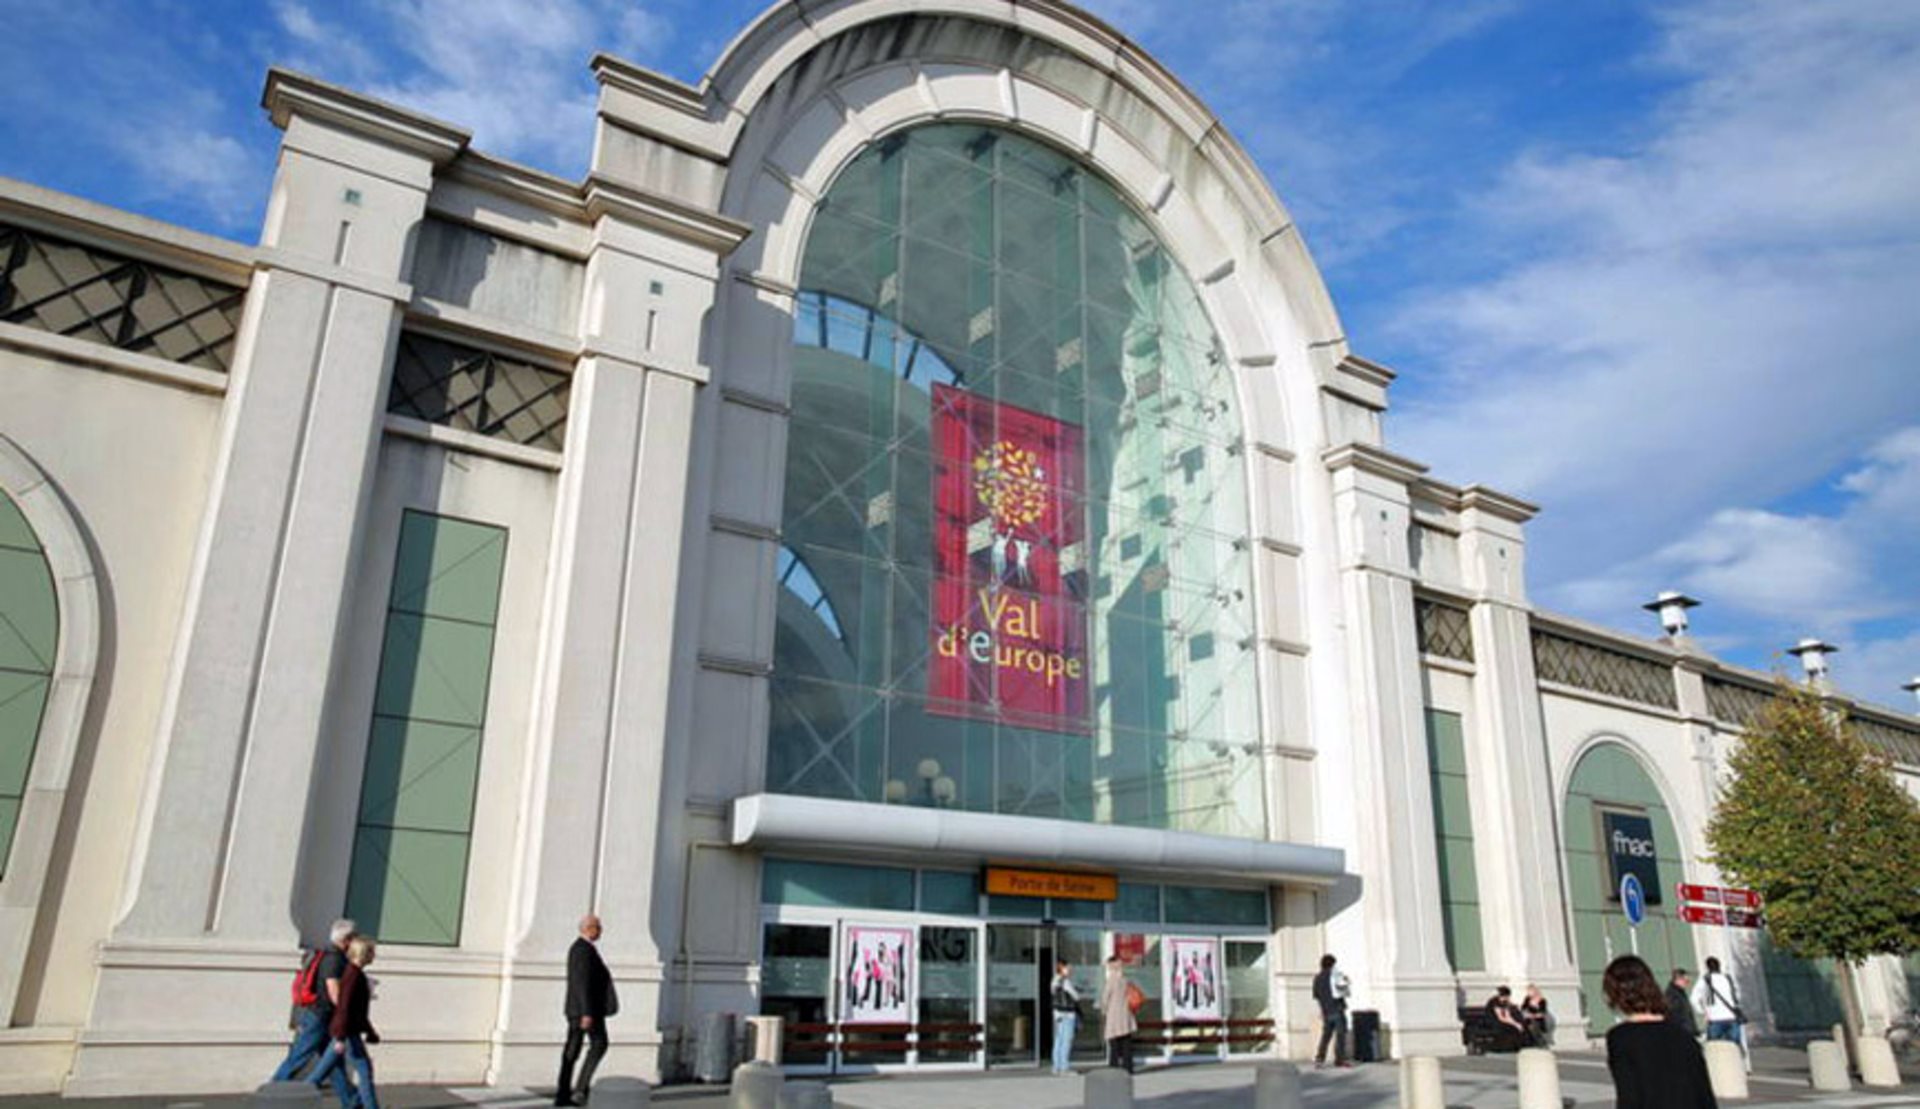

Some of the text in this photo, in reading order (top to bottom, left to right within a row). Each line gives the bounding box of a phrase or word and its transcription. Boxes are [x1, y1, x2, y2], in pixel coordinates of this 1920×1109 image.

[978, 589, 1041, 640] Val
[937, 622, 1081, 686] d'europe
[1612, 830, 1653, 857] fnac
